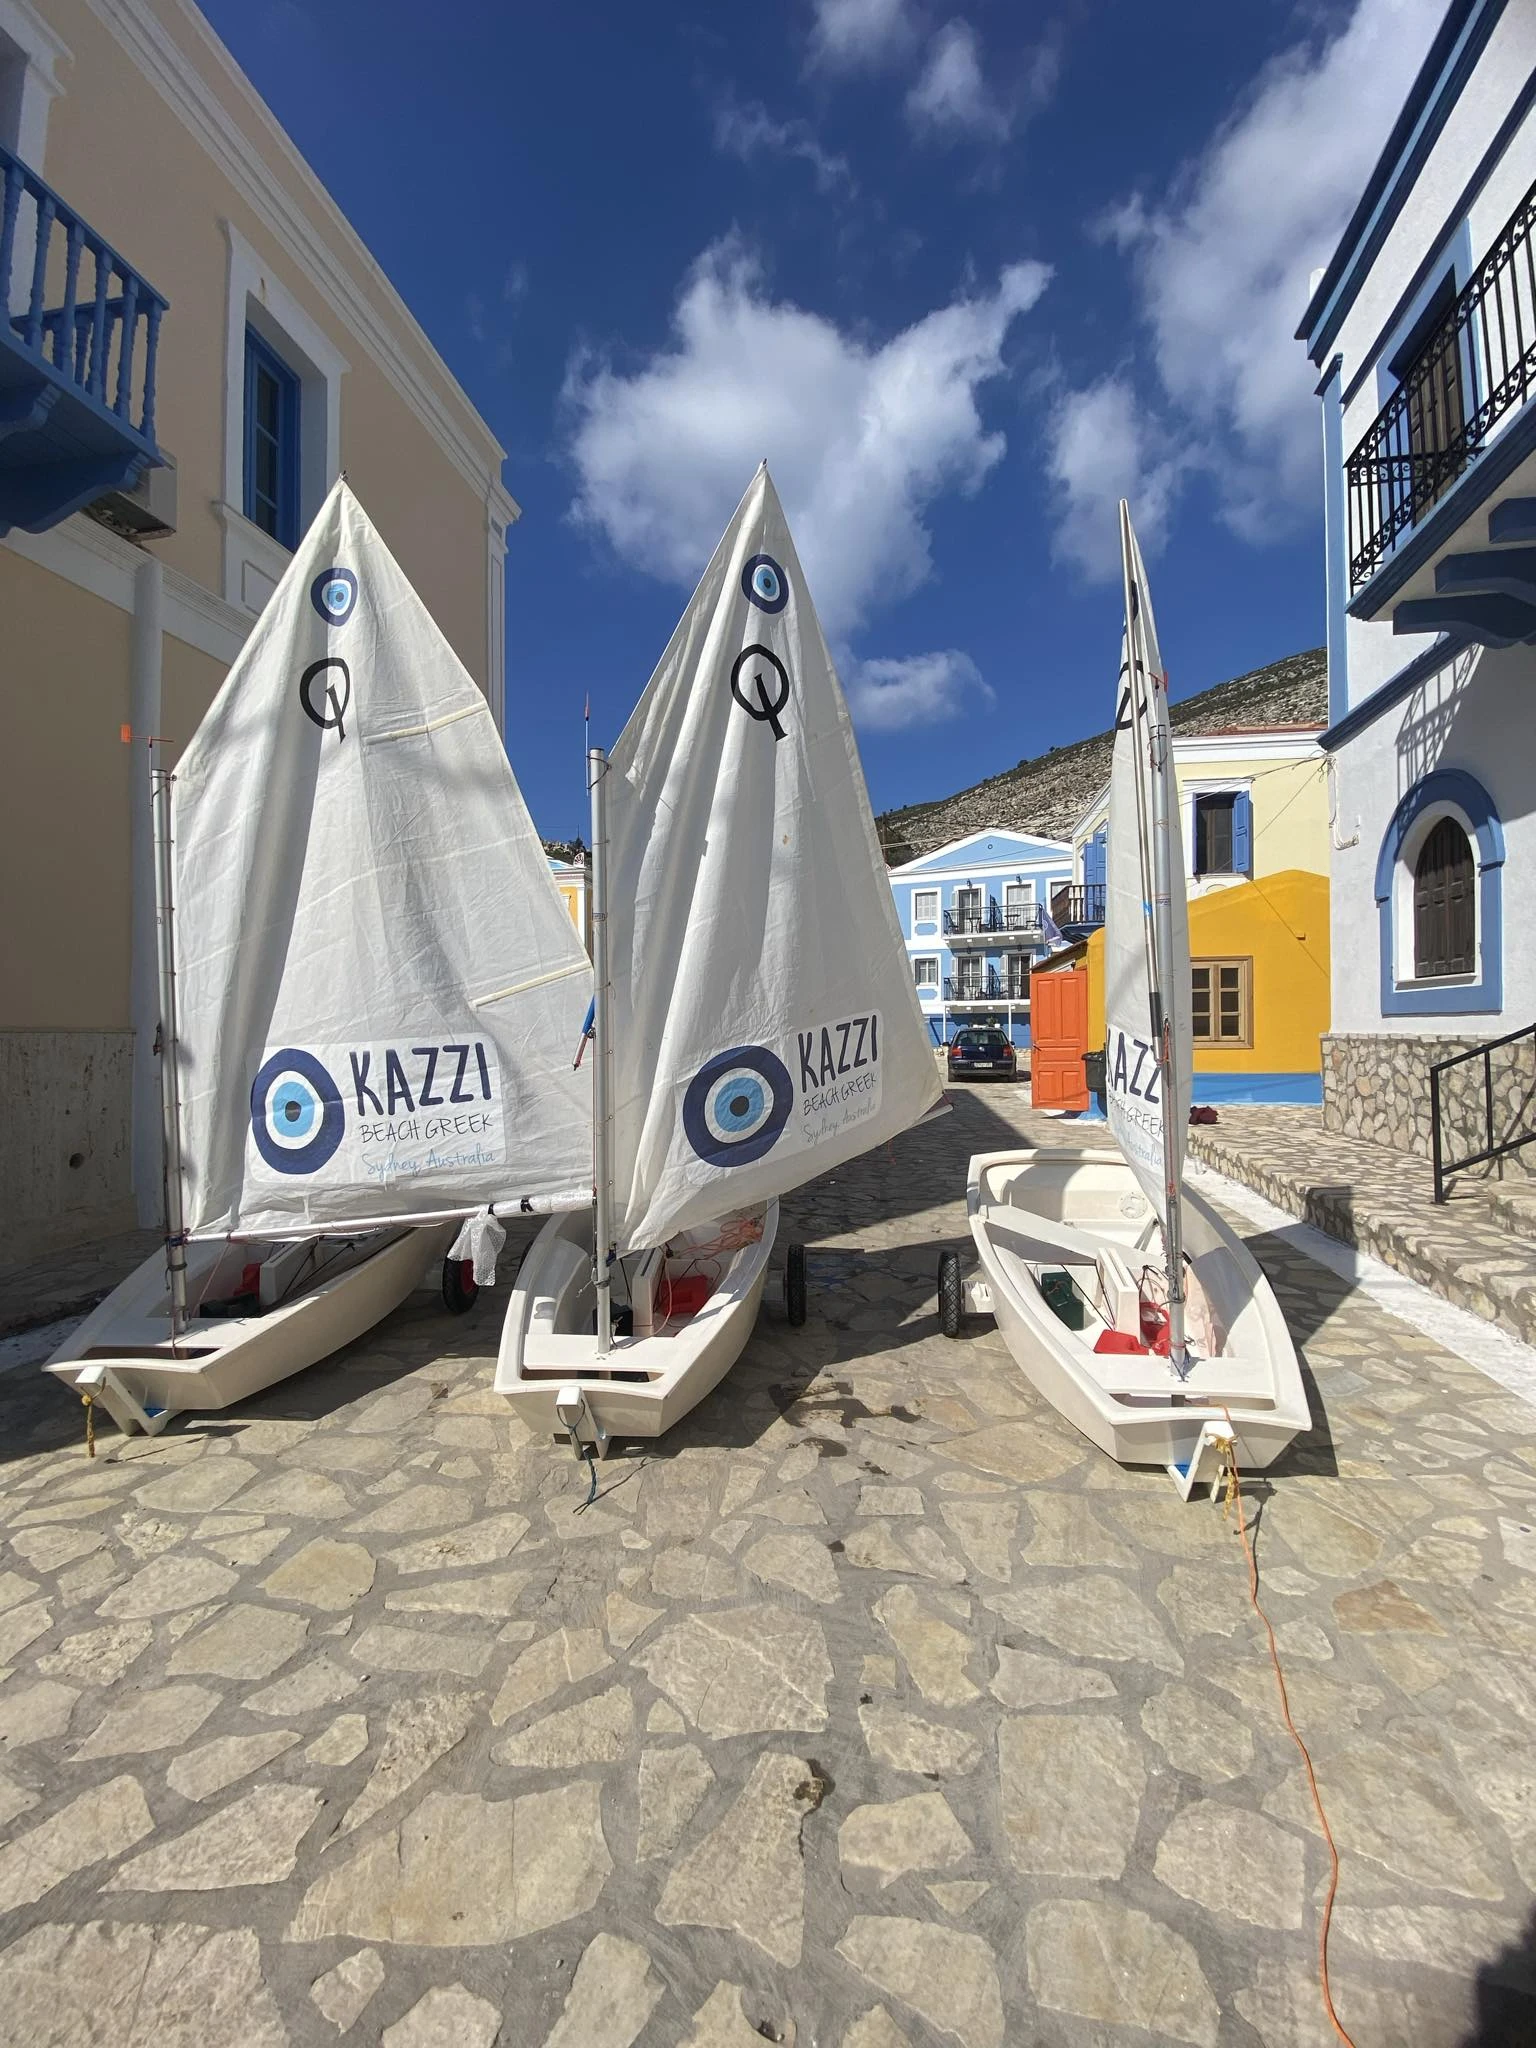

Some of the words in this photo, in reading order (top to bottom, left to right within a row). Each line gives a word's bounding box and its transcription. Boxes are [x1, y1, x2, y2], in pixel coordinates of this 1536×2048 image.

[797, 1014, 877, 1093] KAZZI
[350, 1042, 492, 1116] KAZZI
[803, 1086, 840, 1116] BEACH
[840, 1072, 877, 1101] GREEK
[359, 1119, 420, 1143] BEACH
[425, 1113, 493, 1139] GREEK
[425, 1142, 496, 1168] Australia
